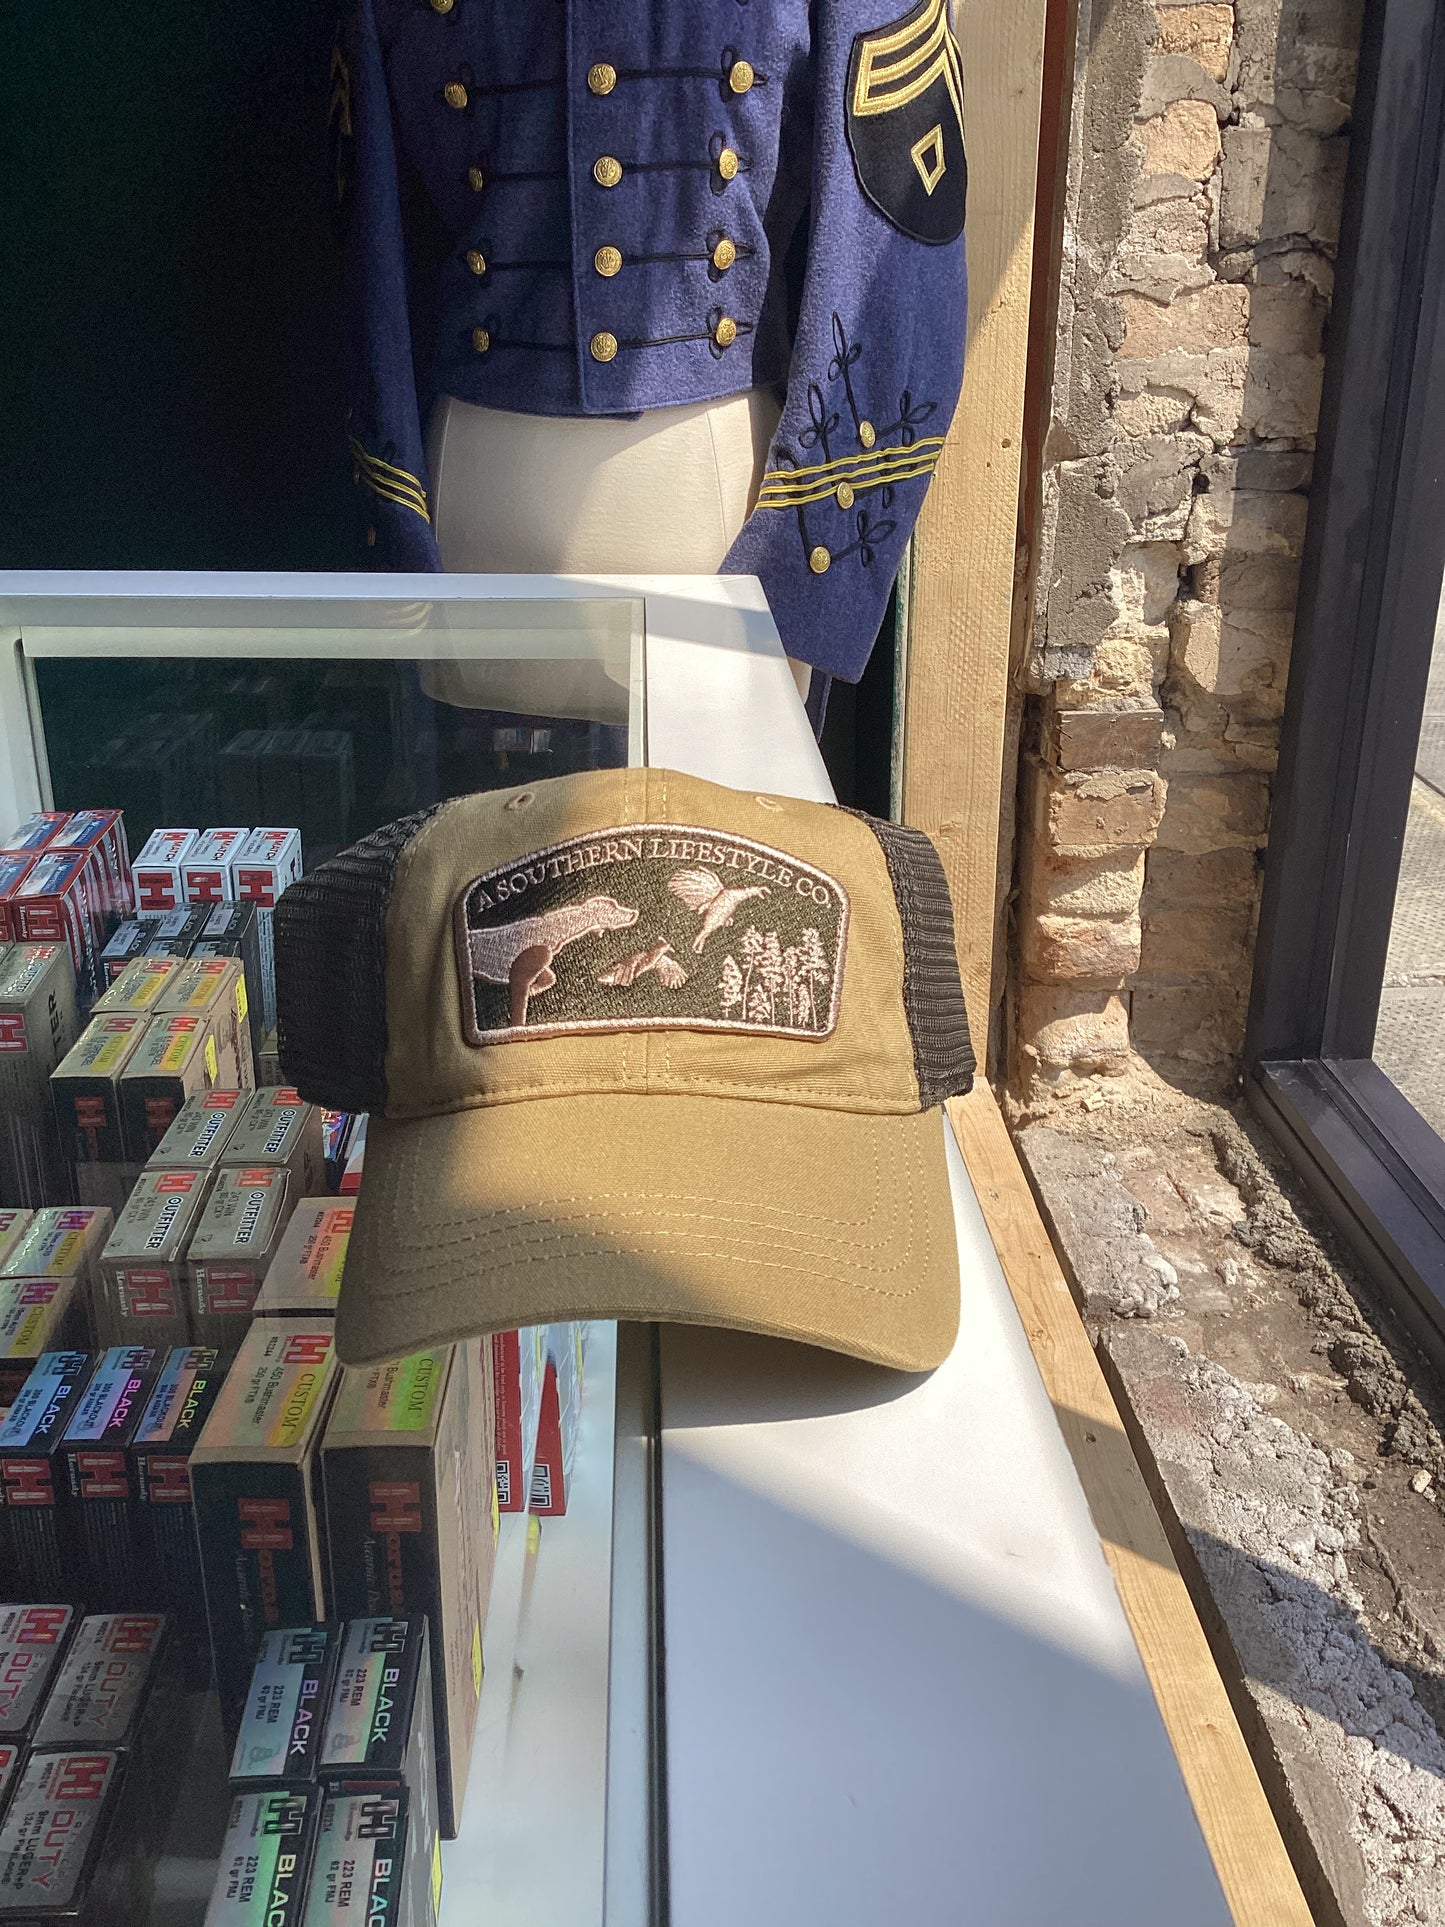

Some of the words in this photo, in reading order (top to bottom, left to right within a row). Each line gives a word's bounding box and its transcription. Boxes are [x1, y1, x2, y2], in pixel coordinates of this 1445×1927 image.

[164, 841, 182, 861] MATCH
[214, 840, 232, 860] MATCH
[265, 840, 283, 860] MATCH
[138, 873, 175, 910] H
[187, 872, 223, 902] H
[238, 870, 274, 907] H
[475, 889, 496, 913] A
[496, 838, 644, 900] SOUTHERN
[648, 838, 793, 888] LIFESTYLE
[794, 877, 833, 909] CO.
[20, 906, 28, 938] Hornady
[25, 905, 60, 938] H
[203, 1092, 240, 1108] H
[273, 1089, 303, 1106] H
[190, 1112, 225, 1157] OUTFITTER
[262, 1110, 296, 1153] OUTFITTER
[158, 1173, 197, 1193] H
[238, 1168, 275, 1187] H
[56, 1211, 95, 1230] H
[146, 1197, 183, 1249] OUTFITTER
[235, 1192, 265, 1244] OUTFITTER
[53, 1231, 80, 1265] CUSTOM
[310, 1243, 329, 1280] Bushmaster
[19, 1282, 60, 1304] H
[116, 1270, 129, 1317] Hornady
[125, 1269, 177, 1316] H
[195, 1268, 207, 1314] Hornady
[208, 1266, 254, 1313] H
[16, 1306, 45, 1345] CUSTOM
[283, 1335, 334, 1364] H
[255, 1366, 268, 1379] 250
[270, 1367, 284, 1381] 450
[378, 1366, 399, 1409] Bushmaster
[408, 1358, 434, 1411] CUSTOM
[35, 1386, 72, 1434] BLACK
[85, 1393, 108, 1427] BLACKOUT
[108, 1379, 142, 1428] BLACK
[177, 1380, 207, 1429] BLACK
[252, 1379, 279, 1425] Bushmaster
[282, 1373, 316, 1428] CUSTOM
[2, 1459, 55, 1504] H
[68, 1453, 78, 1497] Hornady
[77, 1452, 129, 1497] H
[137, 1456, 147, 1500] Hornady
[148, 1456, 193, 1502] H
[16, 1609, 68, 1644] H
[110, 1617, 160, 1653] H
[370, 1622, 408, 1653] H
[288, 1632, 327, 1665] H
[272, 1685, 284, 1701] 223
[356, 1668, 368, 1684] 223
[88, 1662, 127, 1728] DUTY
[256, 1705, 267, 1720] FMJ
[267, 1702, 281, 1723] REM
[339, 1688, 350, 1703] FMJ
[351, 1686, 364, 1707] REM
[372, 1668, 400, 1744] BLACK
[290, 1679, 319, 1755] BLACK
[55, 1756, 110, 1799] H
[24, 1812, 35, 1826] 124
[35, 1810, 49, 1835] 9mm
[263, 1796, 307, 1835] H
[358, 1800, 399, 1839] H
[32, 1810, 75, 1888] DUTY
[247, 1856, 259, 1874] 223
[343, 1860, 356, 1878] 223
[227, 1881, 239, 1898] FMJ
[239, 1876, 254, 1903] REM
[267, 1854, 297, 1927] BLAC
[325, 1883, 337, 1903] FMJ
[338, 1881, 352, 1908] REM
[369, 1858, 393, 1927] BLAC
